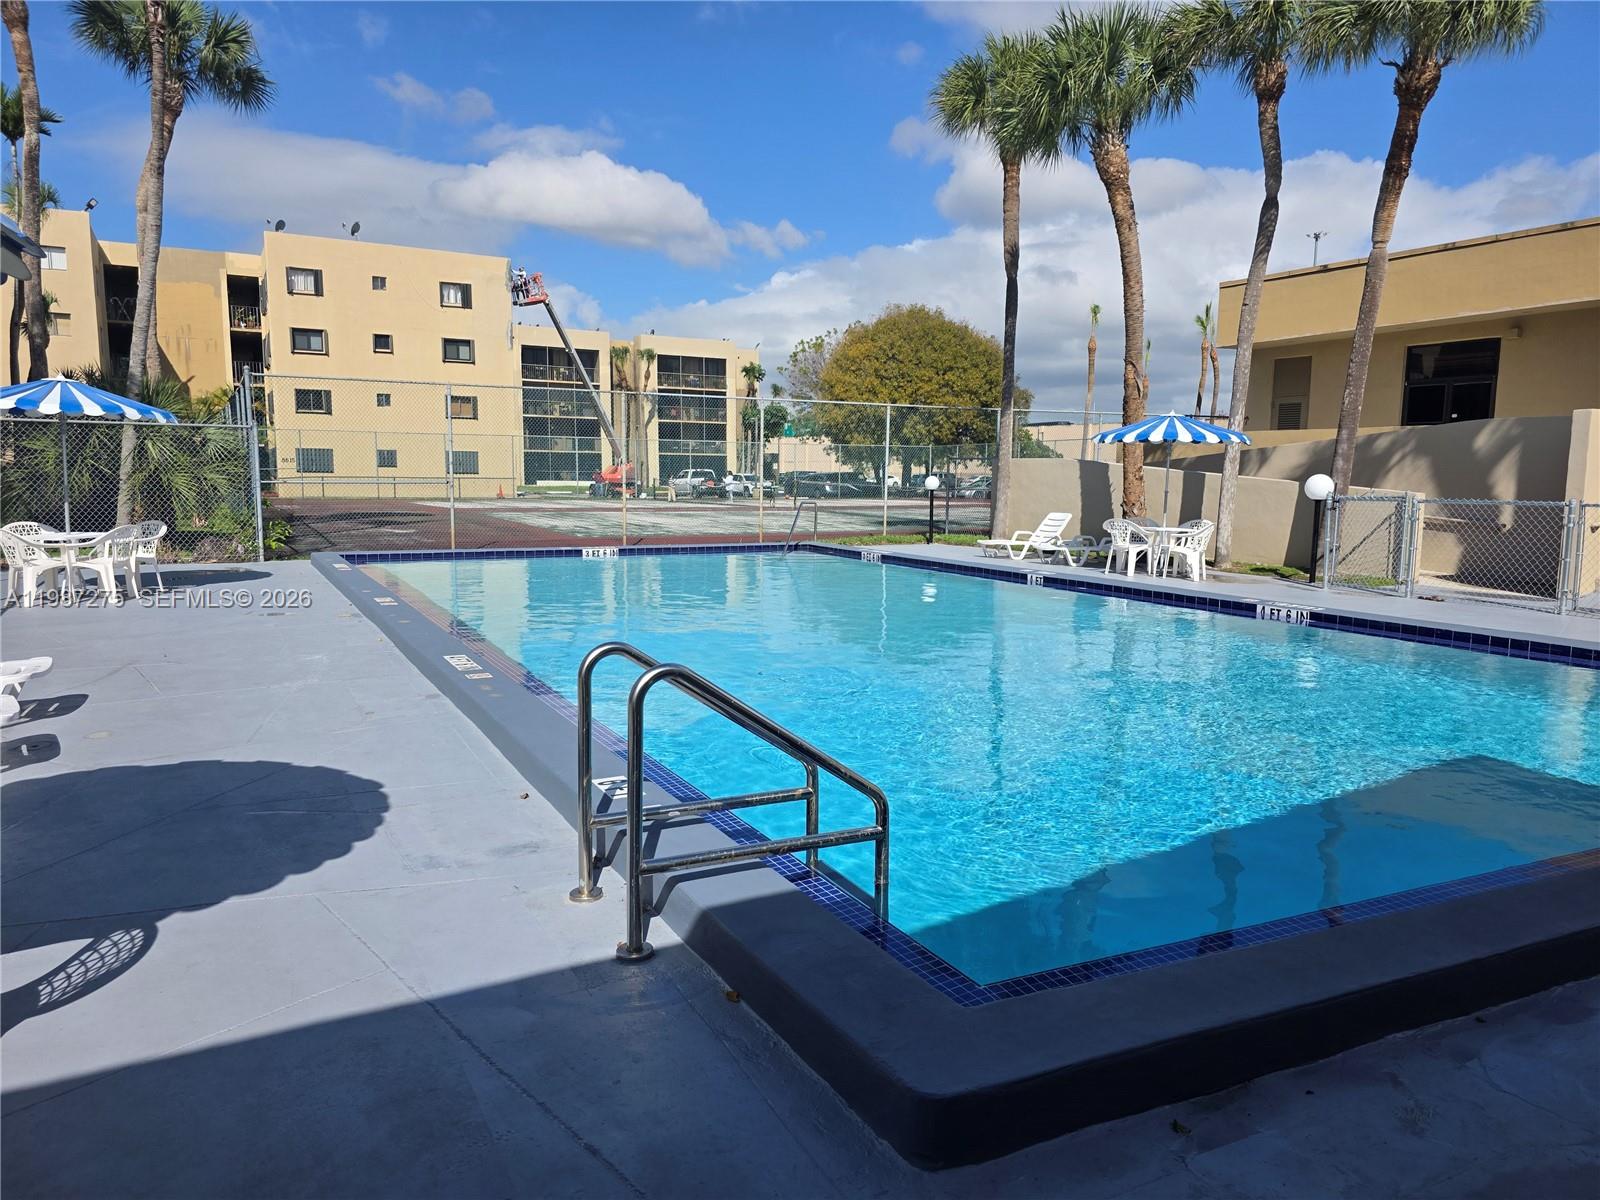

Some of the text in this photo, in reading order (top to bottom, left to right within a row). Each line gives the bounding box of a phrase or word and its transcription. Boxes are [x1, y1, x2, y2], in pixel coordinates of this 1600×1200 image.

[1270, 608, 1281, 621] FT
[1286, 610, 1292, 623] 6
[1296, 611, 1309, 626] IN
